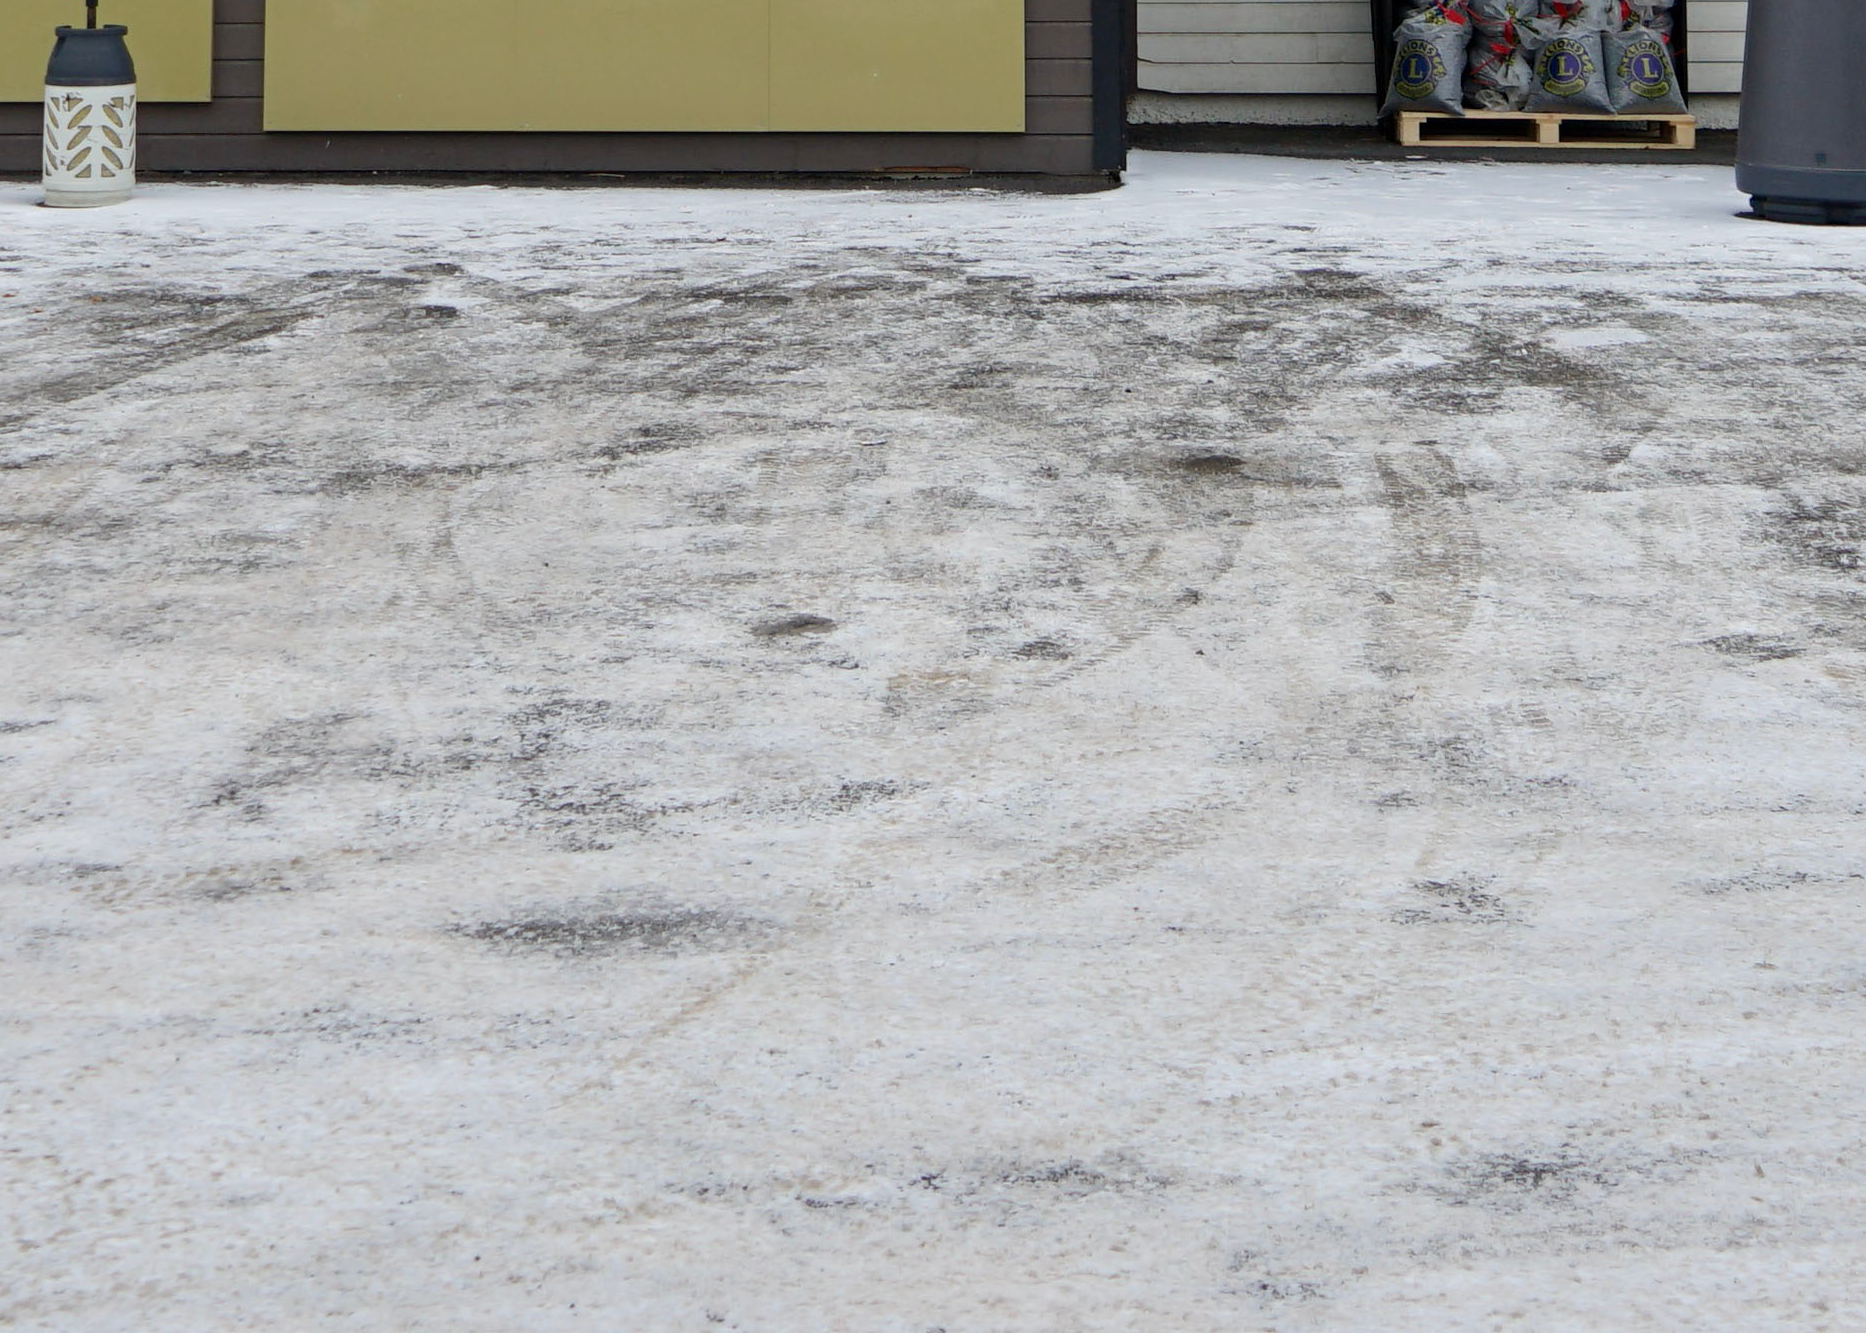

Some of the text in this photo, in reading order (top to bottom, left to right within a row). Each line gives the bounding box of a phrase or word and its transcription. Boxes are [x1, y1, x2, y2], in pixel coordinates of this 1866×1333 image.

[1408, 57, 1423, 79] L
[1557, 56, 1573, 76] L
[1640, 57, 1658, 78] L
